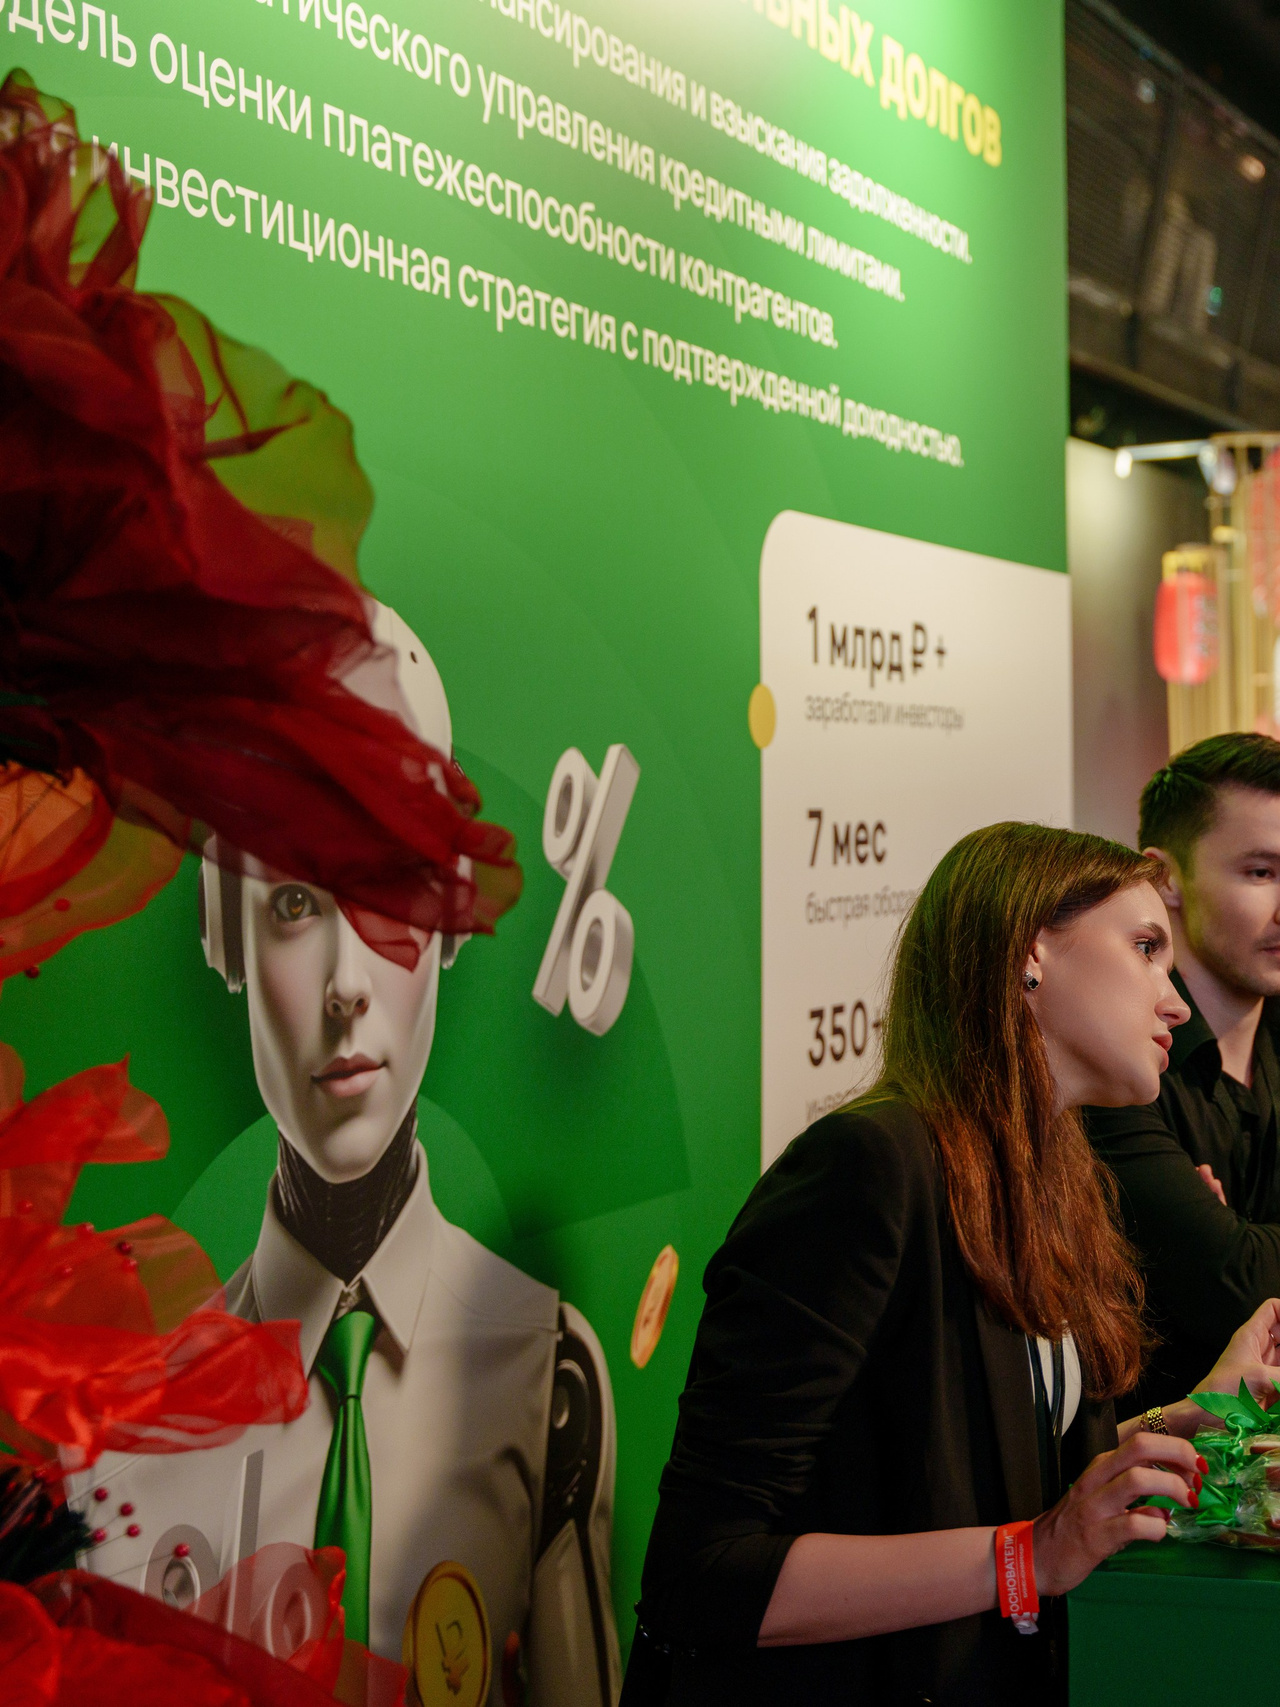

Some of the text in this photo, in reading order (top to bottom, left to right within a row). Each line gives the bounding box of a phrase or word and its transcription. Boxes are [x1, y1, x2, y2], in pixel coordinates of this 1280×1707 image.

[0, 0, 838, 348] дель оценки платежеспособности контрагентов.
[256, 0, 905, 301] ического управления кредитными лимитами.
[489, 0, 973, 265] нсирования и взыскания задолженности.
[880, 34, 1003, 168] долгов
[458, 265, 617, 353] стратегия
[621, 321, 639, 360] с
[643, 327, 842, 428] подтвержденной
[842, 398, 965, 468] доходностью.
[806, 604, 819, 665] 1
[829, 622, 906, 689] млрд
[807, 809, 887, 867] 7 мес
[1004, 1534, 1020, 1612] ОСНОВАТЕЛИ
